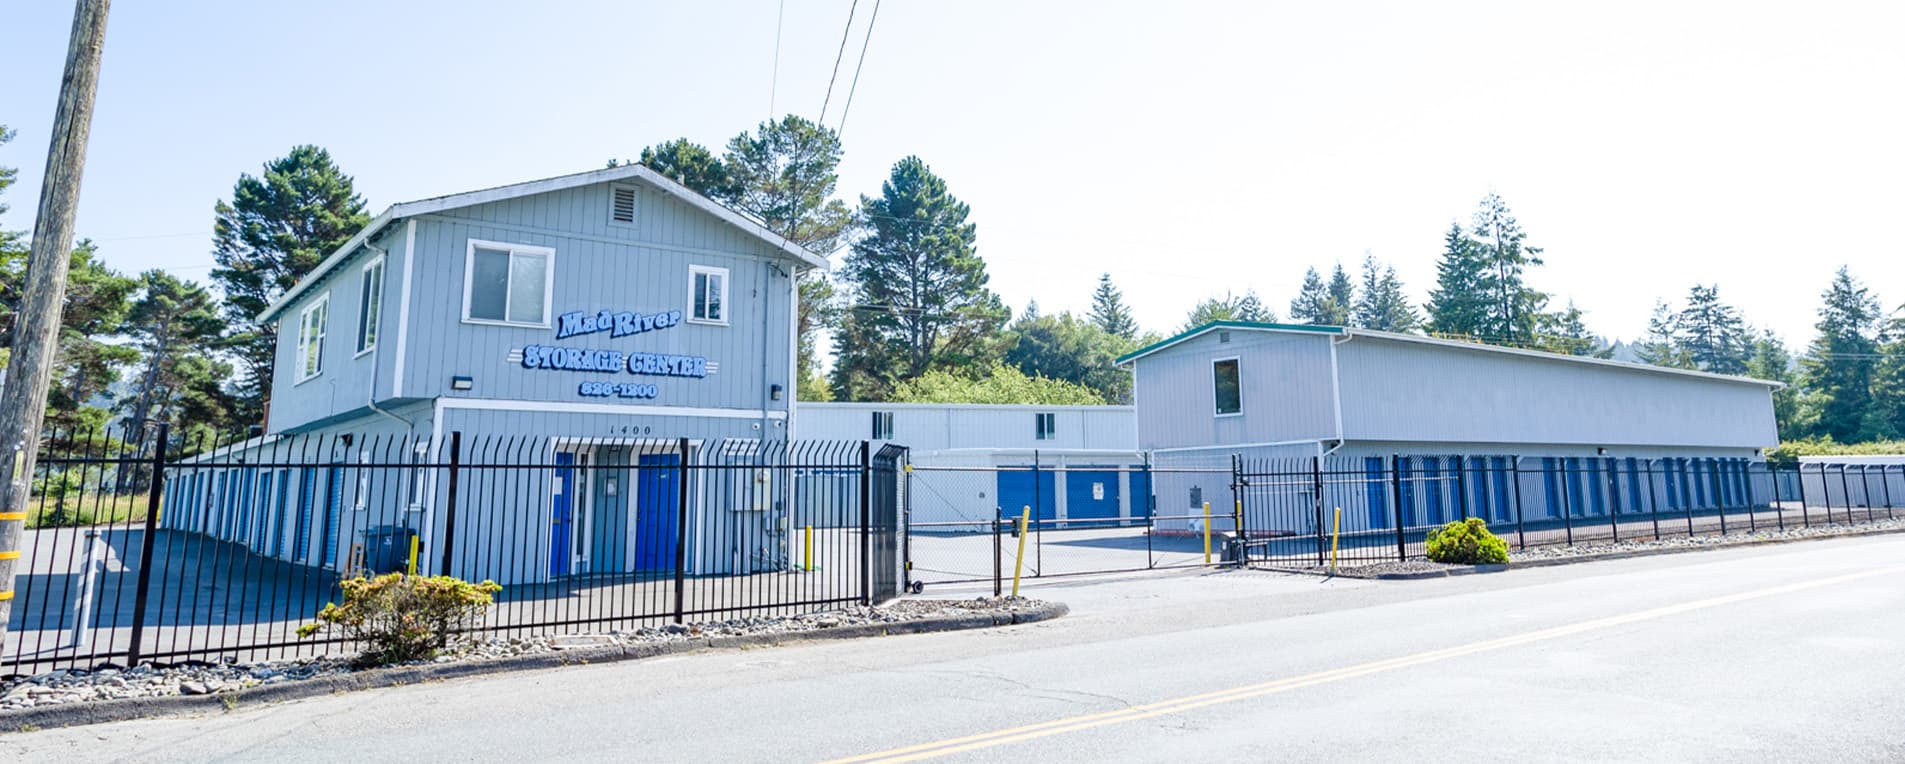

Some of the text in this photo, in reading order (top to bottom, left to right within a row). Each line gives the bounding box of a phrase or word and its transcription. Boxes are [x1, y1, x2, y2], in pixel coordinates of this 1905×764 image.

[556, 309, 681, 339] Mad River
[522, 344, 707, 378] STORAGE CENTER
[610, 426, 651, 435] 1400
